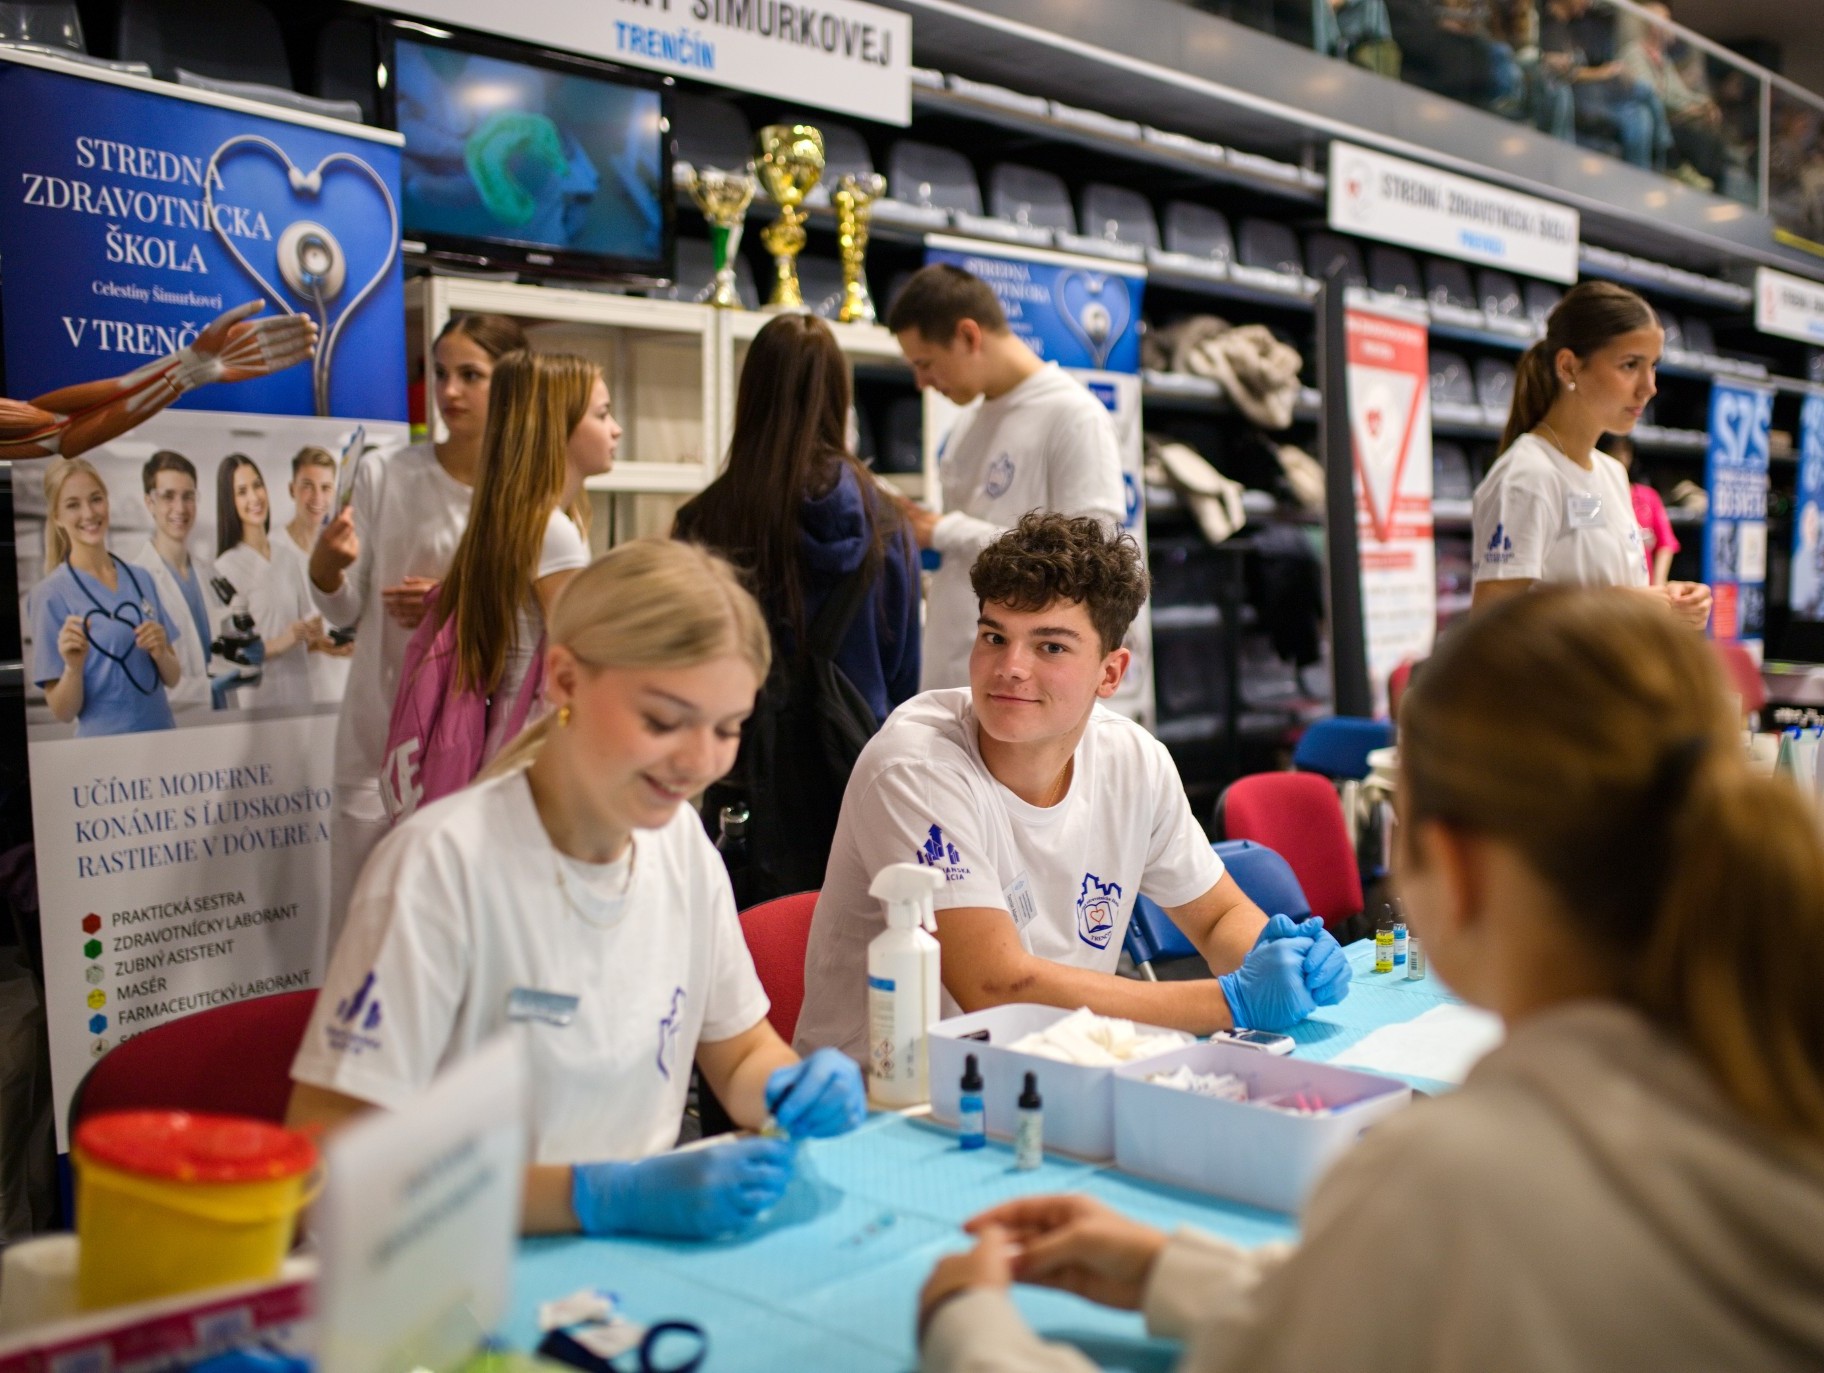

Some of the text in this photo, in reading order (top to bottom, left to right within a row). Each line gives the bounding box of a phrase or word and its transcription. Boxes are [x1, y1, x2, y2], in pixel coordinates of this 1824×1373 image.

[614, 20, 716, 70] TRENČÍN
[106, 222, 208, 274] ŠKOLA
[62, 316, 211, 357] V TRENČ
[73, 763, 273, 808] UČÍME MODERNE
[76, 807, 178, 843] KONÁME
[183, 805, 197, 829] S
[78, 821, 329, 878] RASTIEME V DÔVERE A
[112, 891, 246, 927] PRAKTICKÁ SESTRA
[226, 903, 299, 930] LABORANT
[166, 939, 234, 966] ASISTENT
[117, 977, 167, 1001] MASÉR
[118, 969, 311, 1026] FARMACEUTICKÝ LABORANT
